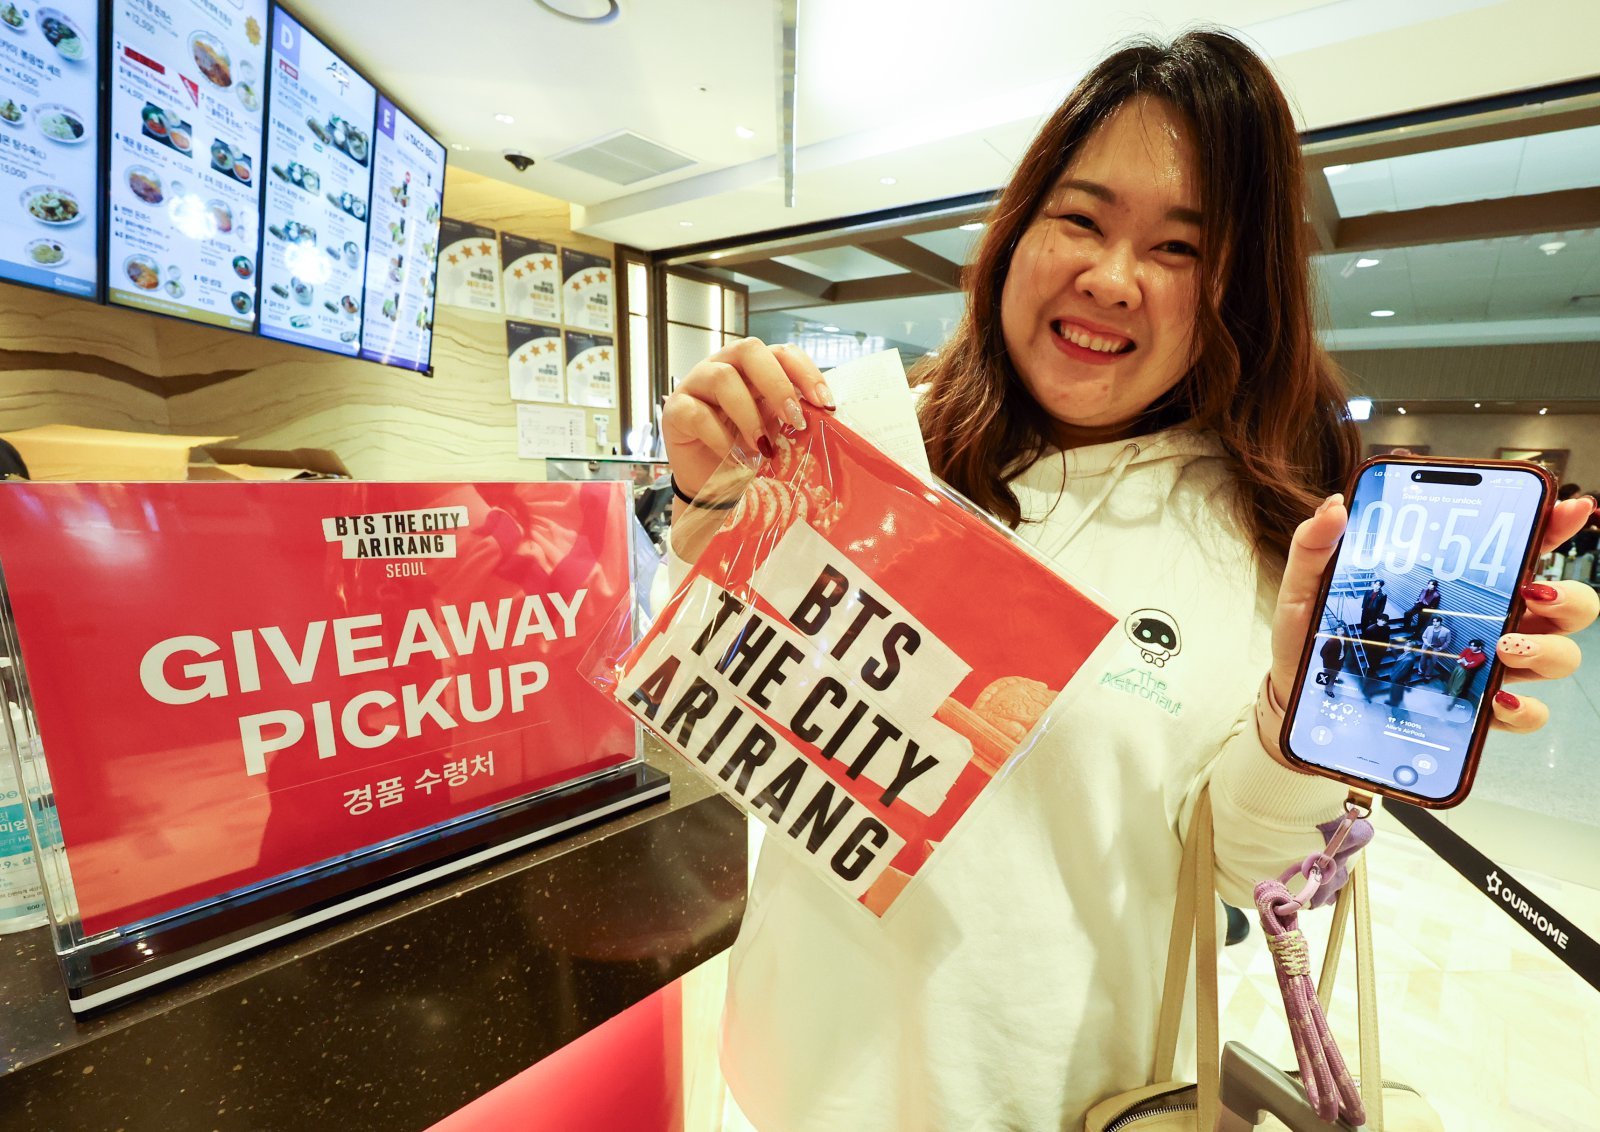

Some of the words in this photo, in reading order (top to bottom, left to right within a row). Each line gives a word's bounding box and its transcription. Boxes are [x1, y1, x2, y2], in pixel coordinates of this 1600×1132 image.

[281, 24, 294, 49] D
[383, 109, 391, 129] E
[335, 515, 375, 536] BTS
[382, 514, 416, 534] THE
[422, 512, 460, 532] CITY
[1429, 495, 1440, 504] up
[1453, 497, 1482, 505] unlock
[357, 535, 444, 558] ARIRANG
[385, 562, 427, 578] SEOUL
[1352, 500, 1515, 588] 09:54
[139, 588, 589, 706] GIVEAWAY
[788, 563, 922, 692] BTS
[691, 590, 806, 711] THE
[789, 676, 940, 808] CITY
[1100, 669, 1182, 716] Astronaut
[1138, 669, 1167, 691] The
[238, 660, 550, 777] PICKUP
[342, 776, 405, 816] 경품
[414, 751, 496, 796] 수령처
[627, 654, 890, 882] ARIRANG
[1501, 887, 1569, 950] OURHOME
